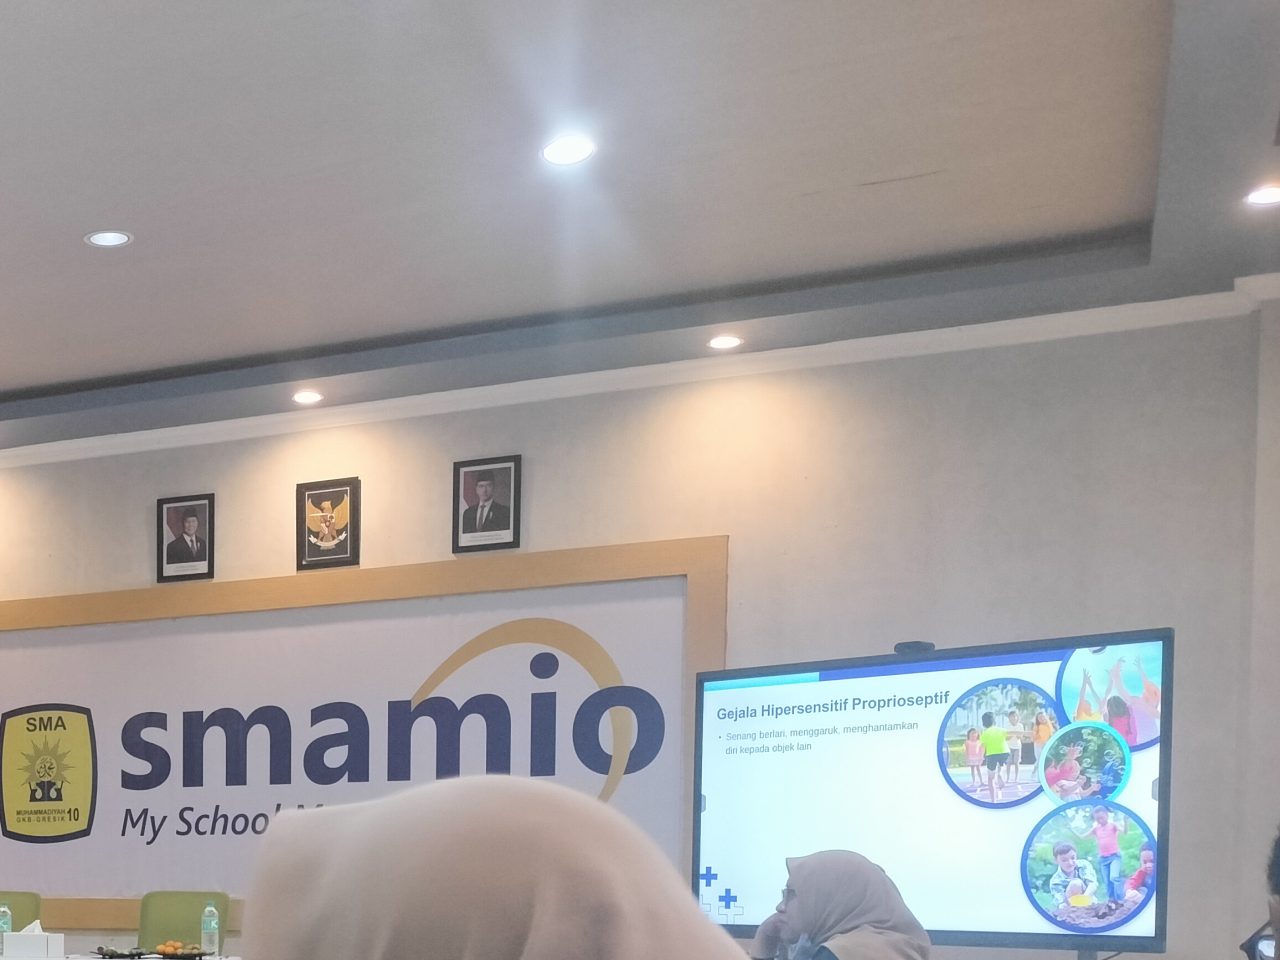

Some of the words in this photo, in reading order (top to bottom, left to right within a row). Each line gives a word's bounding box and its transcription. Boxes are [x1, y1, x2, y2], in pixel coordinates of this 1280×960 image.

[717, 706, 757, 721] Gejala
[761, 698, 848, 719] Hipersensitif
[852, 690, 950, 712] Proprioseptif
[26, 716, 67, 732] SMA
[120, 652, 665, 791] smamio
[726, 732, 757, 741] Senang
[759, 729, 787, 739] berlari,
[790, 725, 840, 738] menggaruk,
[843, 721, 919, 734] menghantamkan
[725, 746, 738, 755] diri
[740, 744, 770, 755] kepada
[772, 742, 795, 753] objek
[797, 742, 812, 751] lain
[15, 808, 66, 816] MUHAMMADIYAH
[66, 807, 80, 822] 10
[121, 808, 168, 846] My
